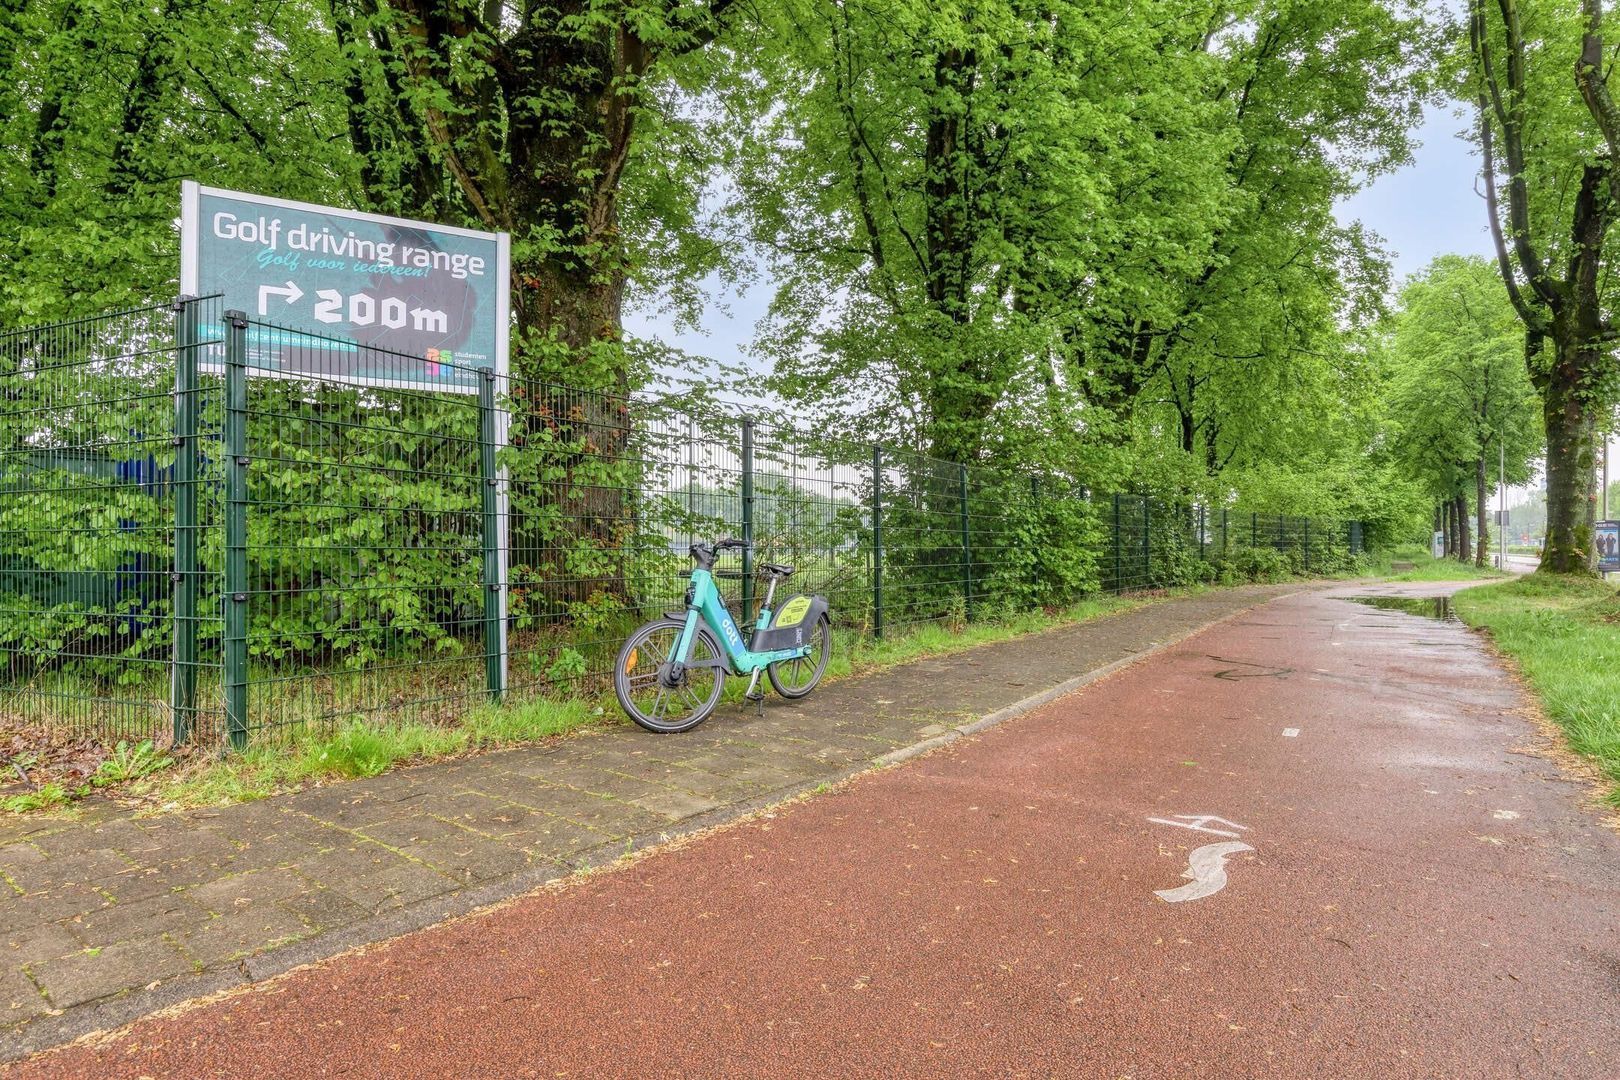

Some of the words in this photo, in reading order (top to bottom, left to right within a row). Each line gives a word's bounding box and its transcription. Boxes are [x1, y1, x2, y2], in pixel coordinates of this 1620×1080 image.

[213, 212, 281, 250] Golf
[287, 223, 395, 268] driving
[402, 246, 485, 279] range
[256, 247, 300, 271] Golf
[305, 257, 346, 271] voor
[314, 289, 447, 333] 200m
[722, 618, 738, 647] dott
